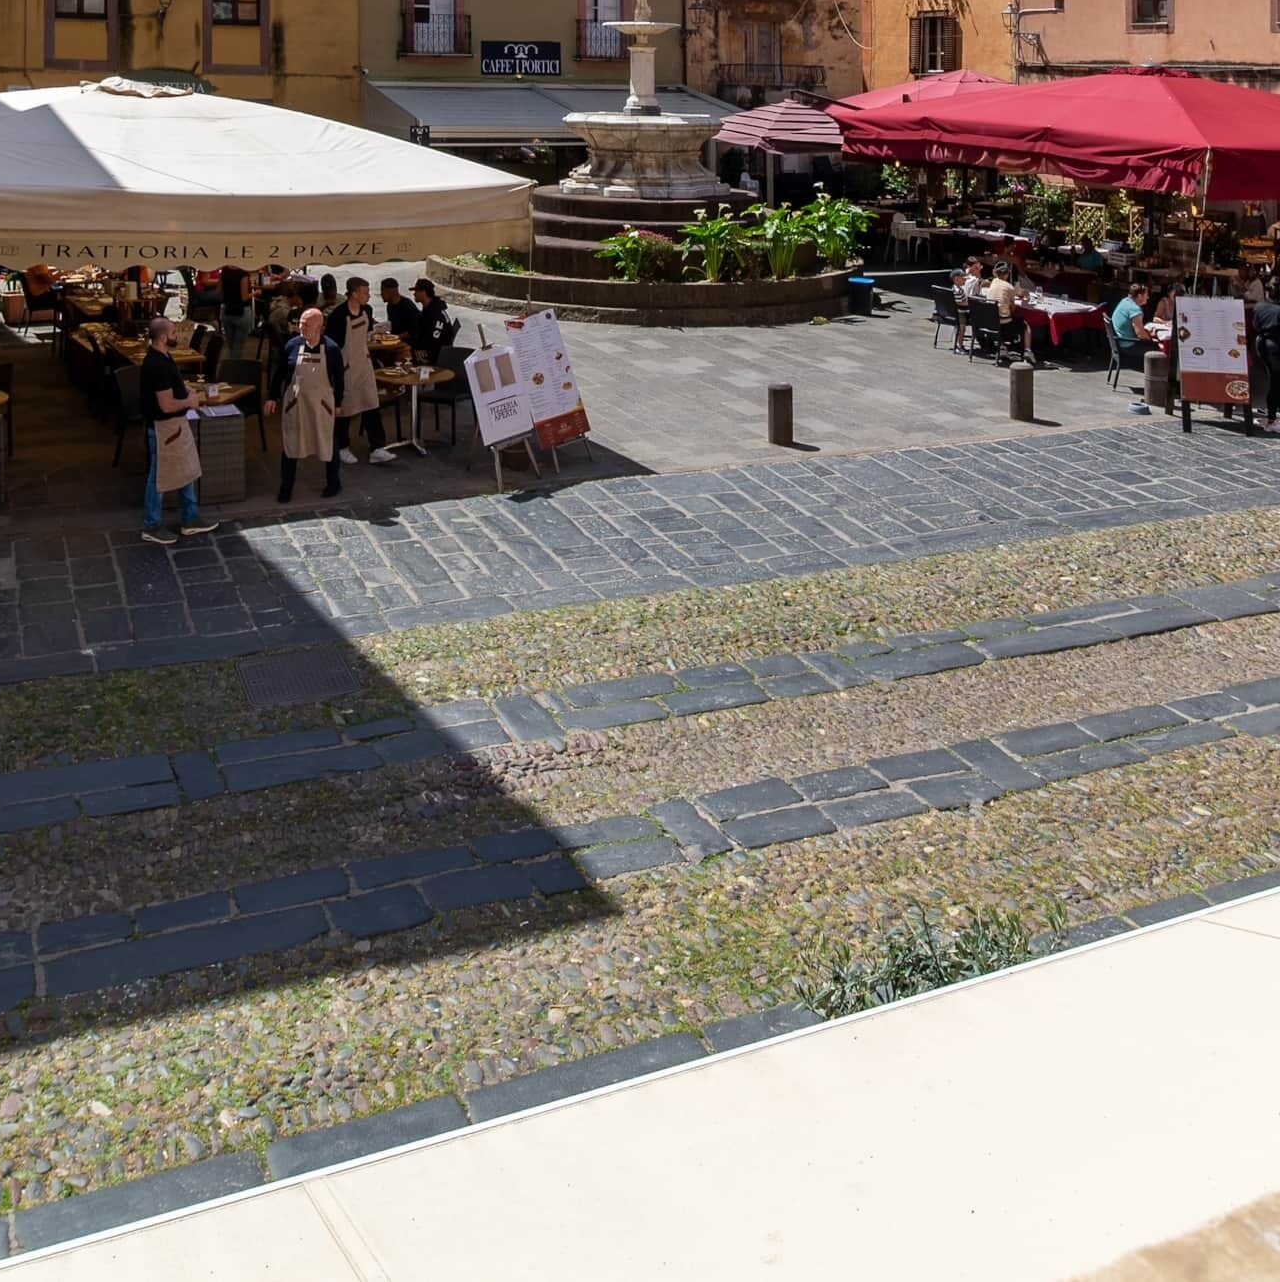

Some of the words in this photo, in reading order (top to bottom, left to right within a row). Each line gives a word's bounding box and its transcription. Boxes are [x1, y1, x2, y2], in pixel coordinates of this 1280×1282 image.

[522, 59, 560, 74] PORTICI
[36, 243, 209, 259] TRATTORIA
[224, 245, 254, 259] LE
[268, 245, 280, 259] 2
[293, 242, 384, 258] PIAZZE
